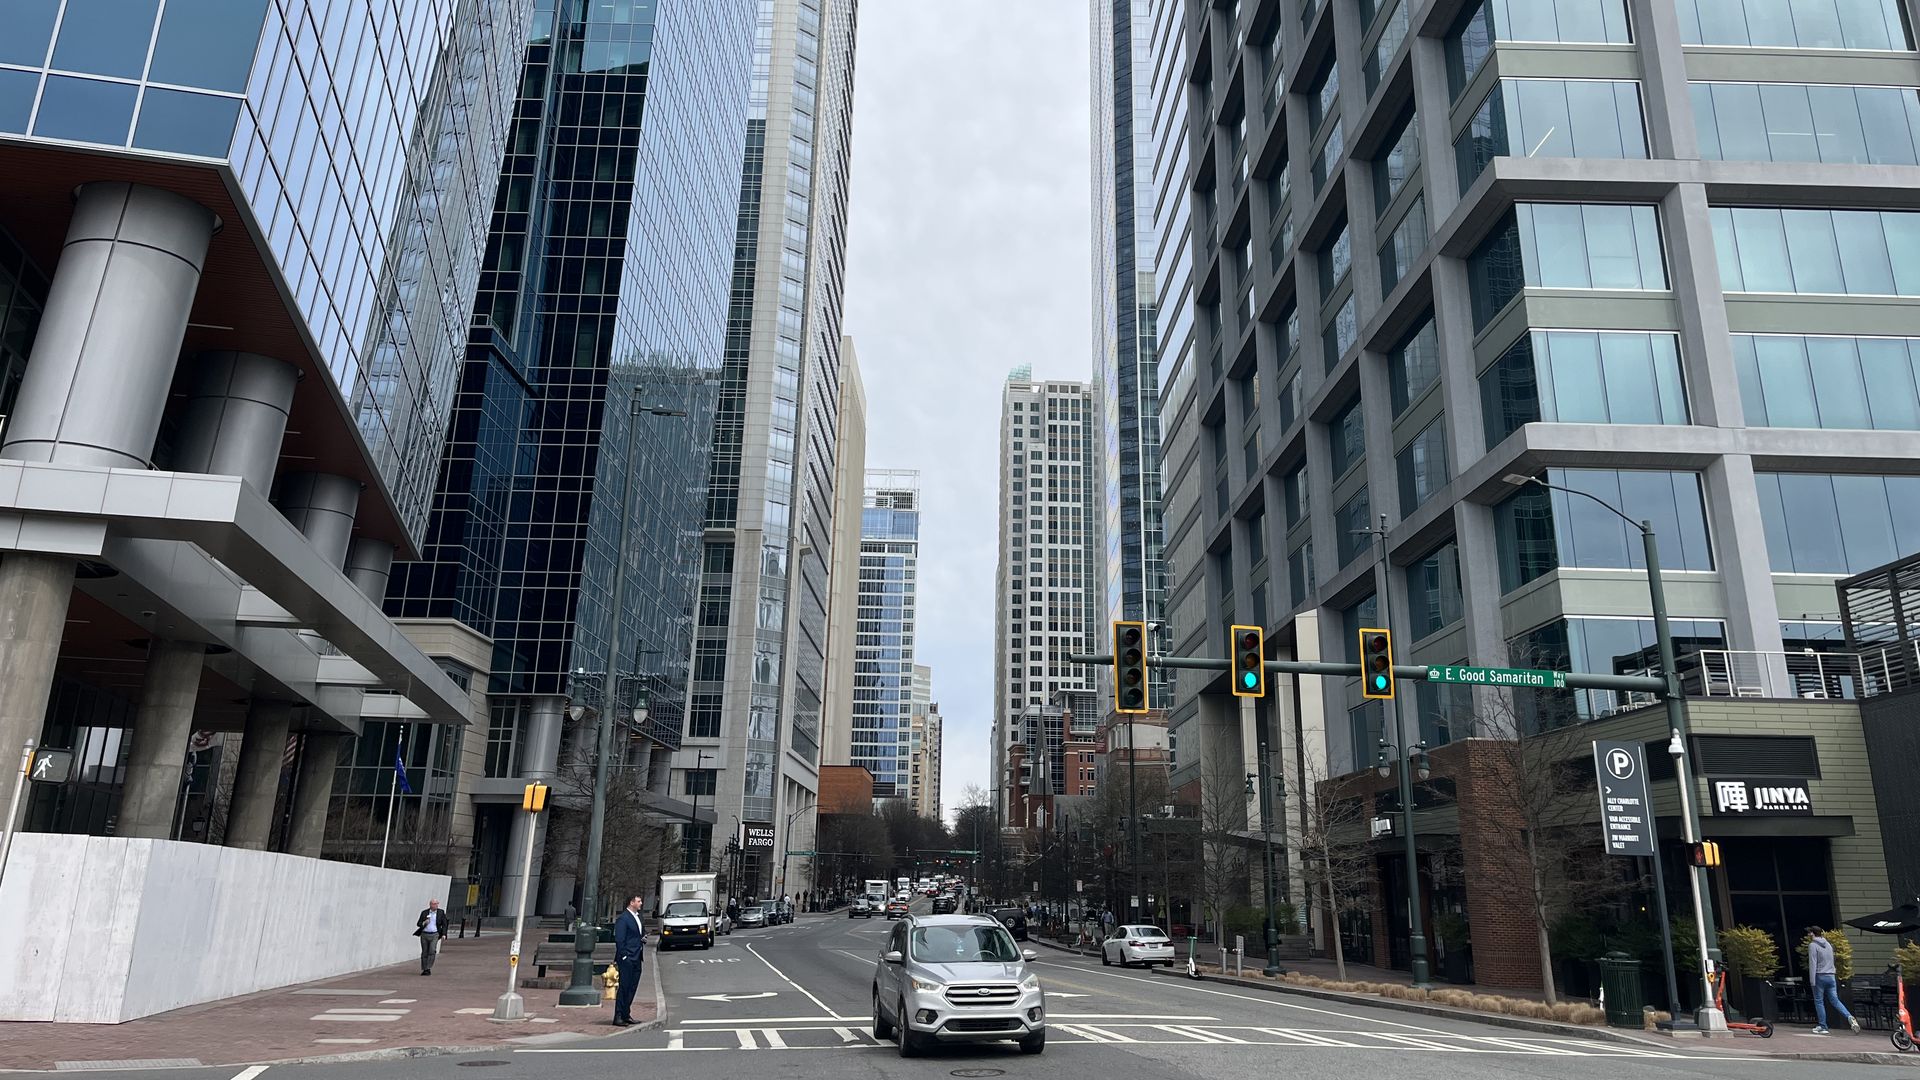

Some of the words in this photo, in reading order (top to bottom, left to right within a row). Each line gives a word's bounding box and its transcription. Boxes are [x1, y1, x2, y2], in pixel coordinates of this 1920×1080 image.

[1445, 668, 1455, 681] E.
[1459, 668, 1485, 682] Good
[1490, 670, 1544, 684] Samaritan
[1553, 671, 1564, 680] Way
[1613, 753, 1629, 775] P
[1754, 788, 1809, 809] JINYA
[748, 829, 774, 837] WELLS
[748, 838, 773, 846] FARGO
